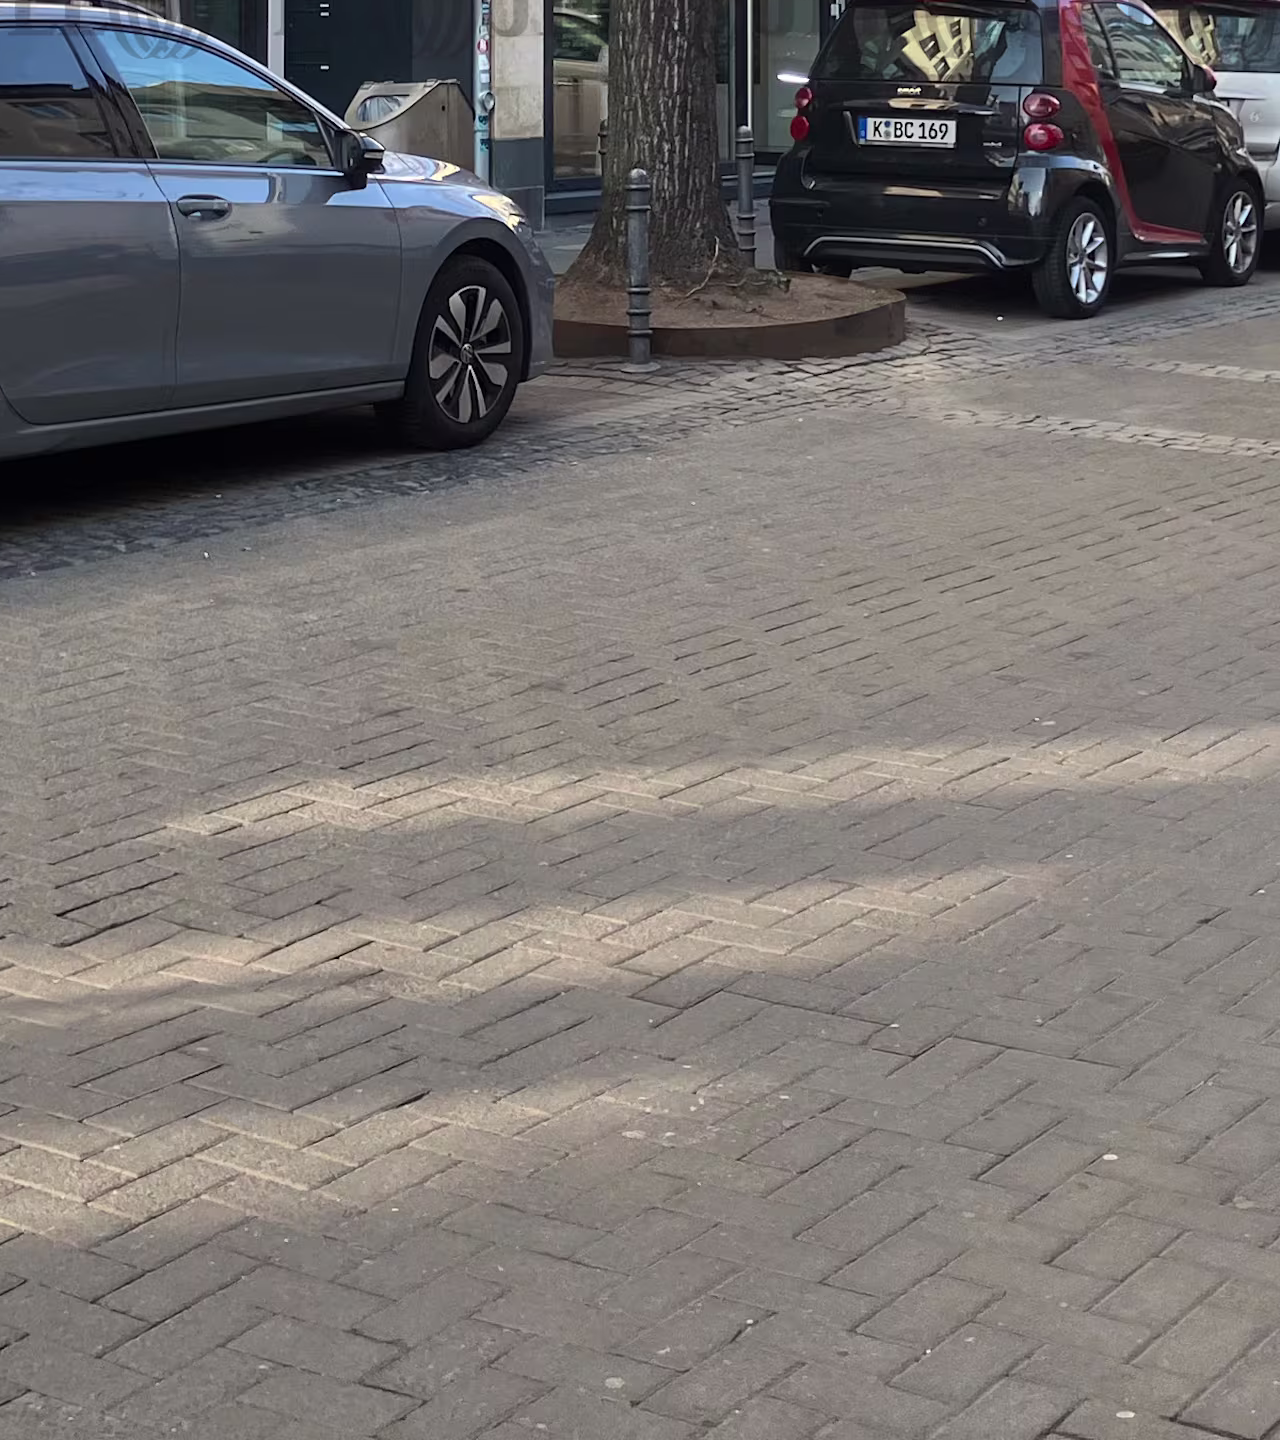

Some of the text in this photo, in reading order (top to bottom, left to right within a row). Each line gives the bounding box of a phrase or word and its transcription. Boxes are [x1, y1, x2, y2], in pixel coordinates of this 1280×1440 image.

[873, 120, 949, 141] K BC 169
